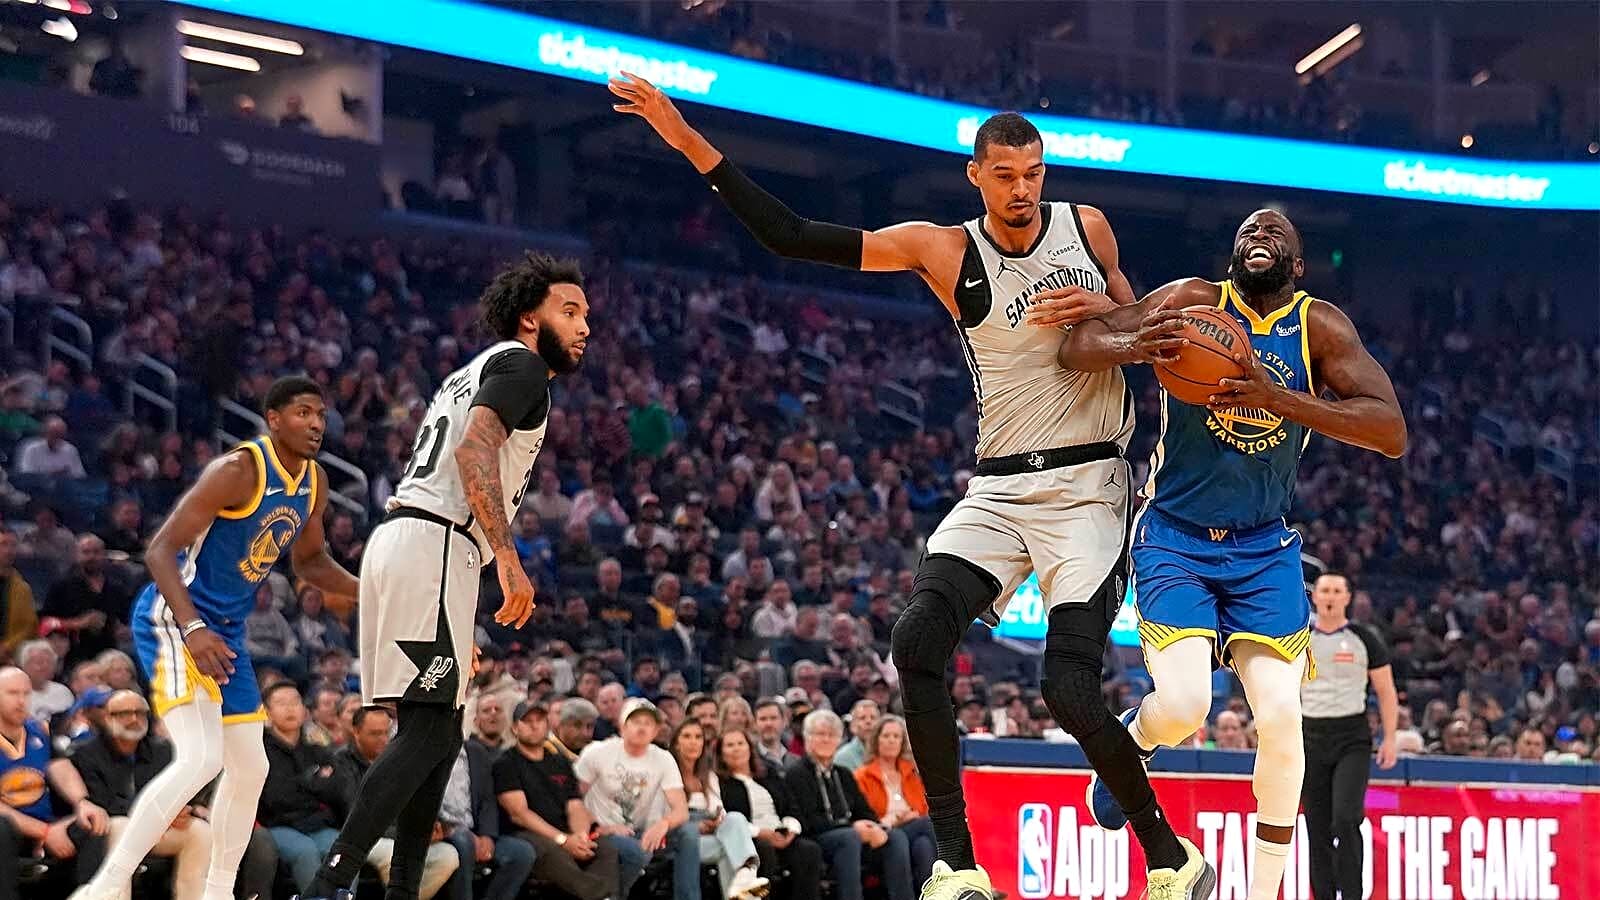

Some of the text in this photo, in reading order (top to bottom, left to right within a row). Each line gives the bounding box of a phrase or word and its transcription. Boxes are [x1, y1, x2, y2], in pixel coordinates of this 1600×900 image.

[538, 32, 717, 94] ticketmaster
[957, 116, 1132, 162] timaster
[1384, 160, 1549, 202] ticketmaster
[1265, 351, 1294, 380] STATE
[1205, 415, 1287, 455] WARRIORS
[1053, 805, 1130, 900] App
[1381, 815, 1454, 900] THE
[1459, 816, 1560, 900] GAME
